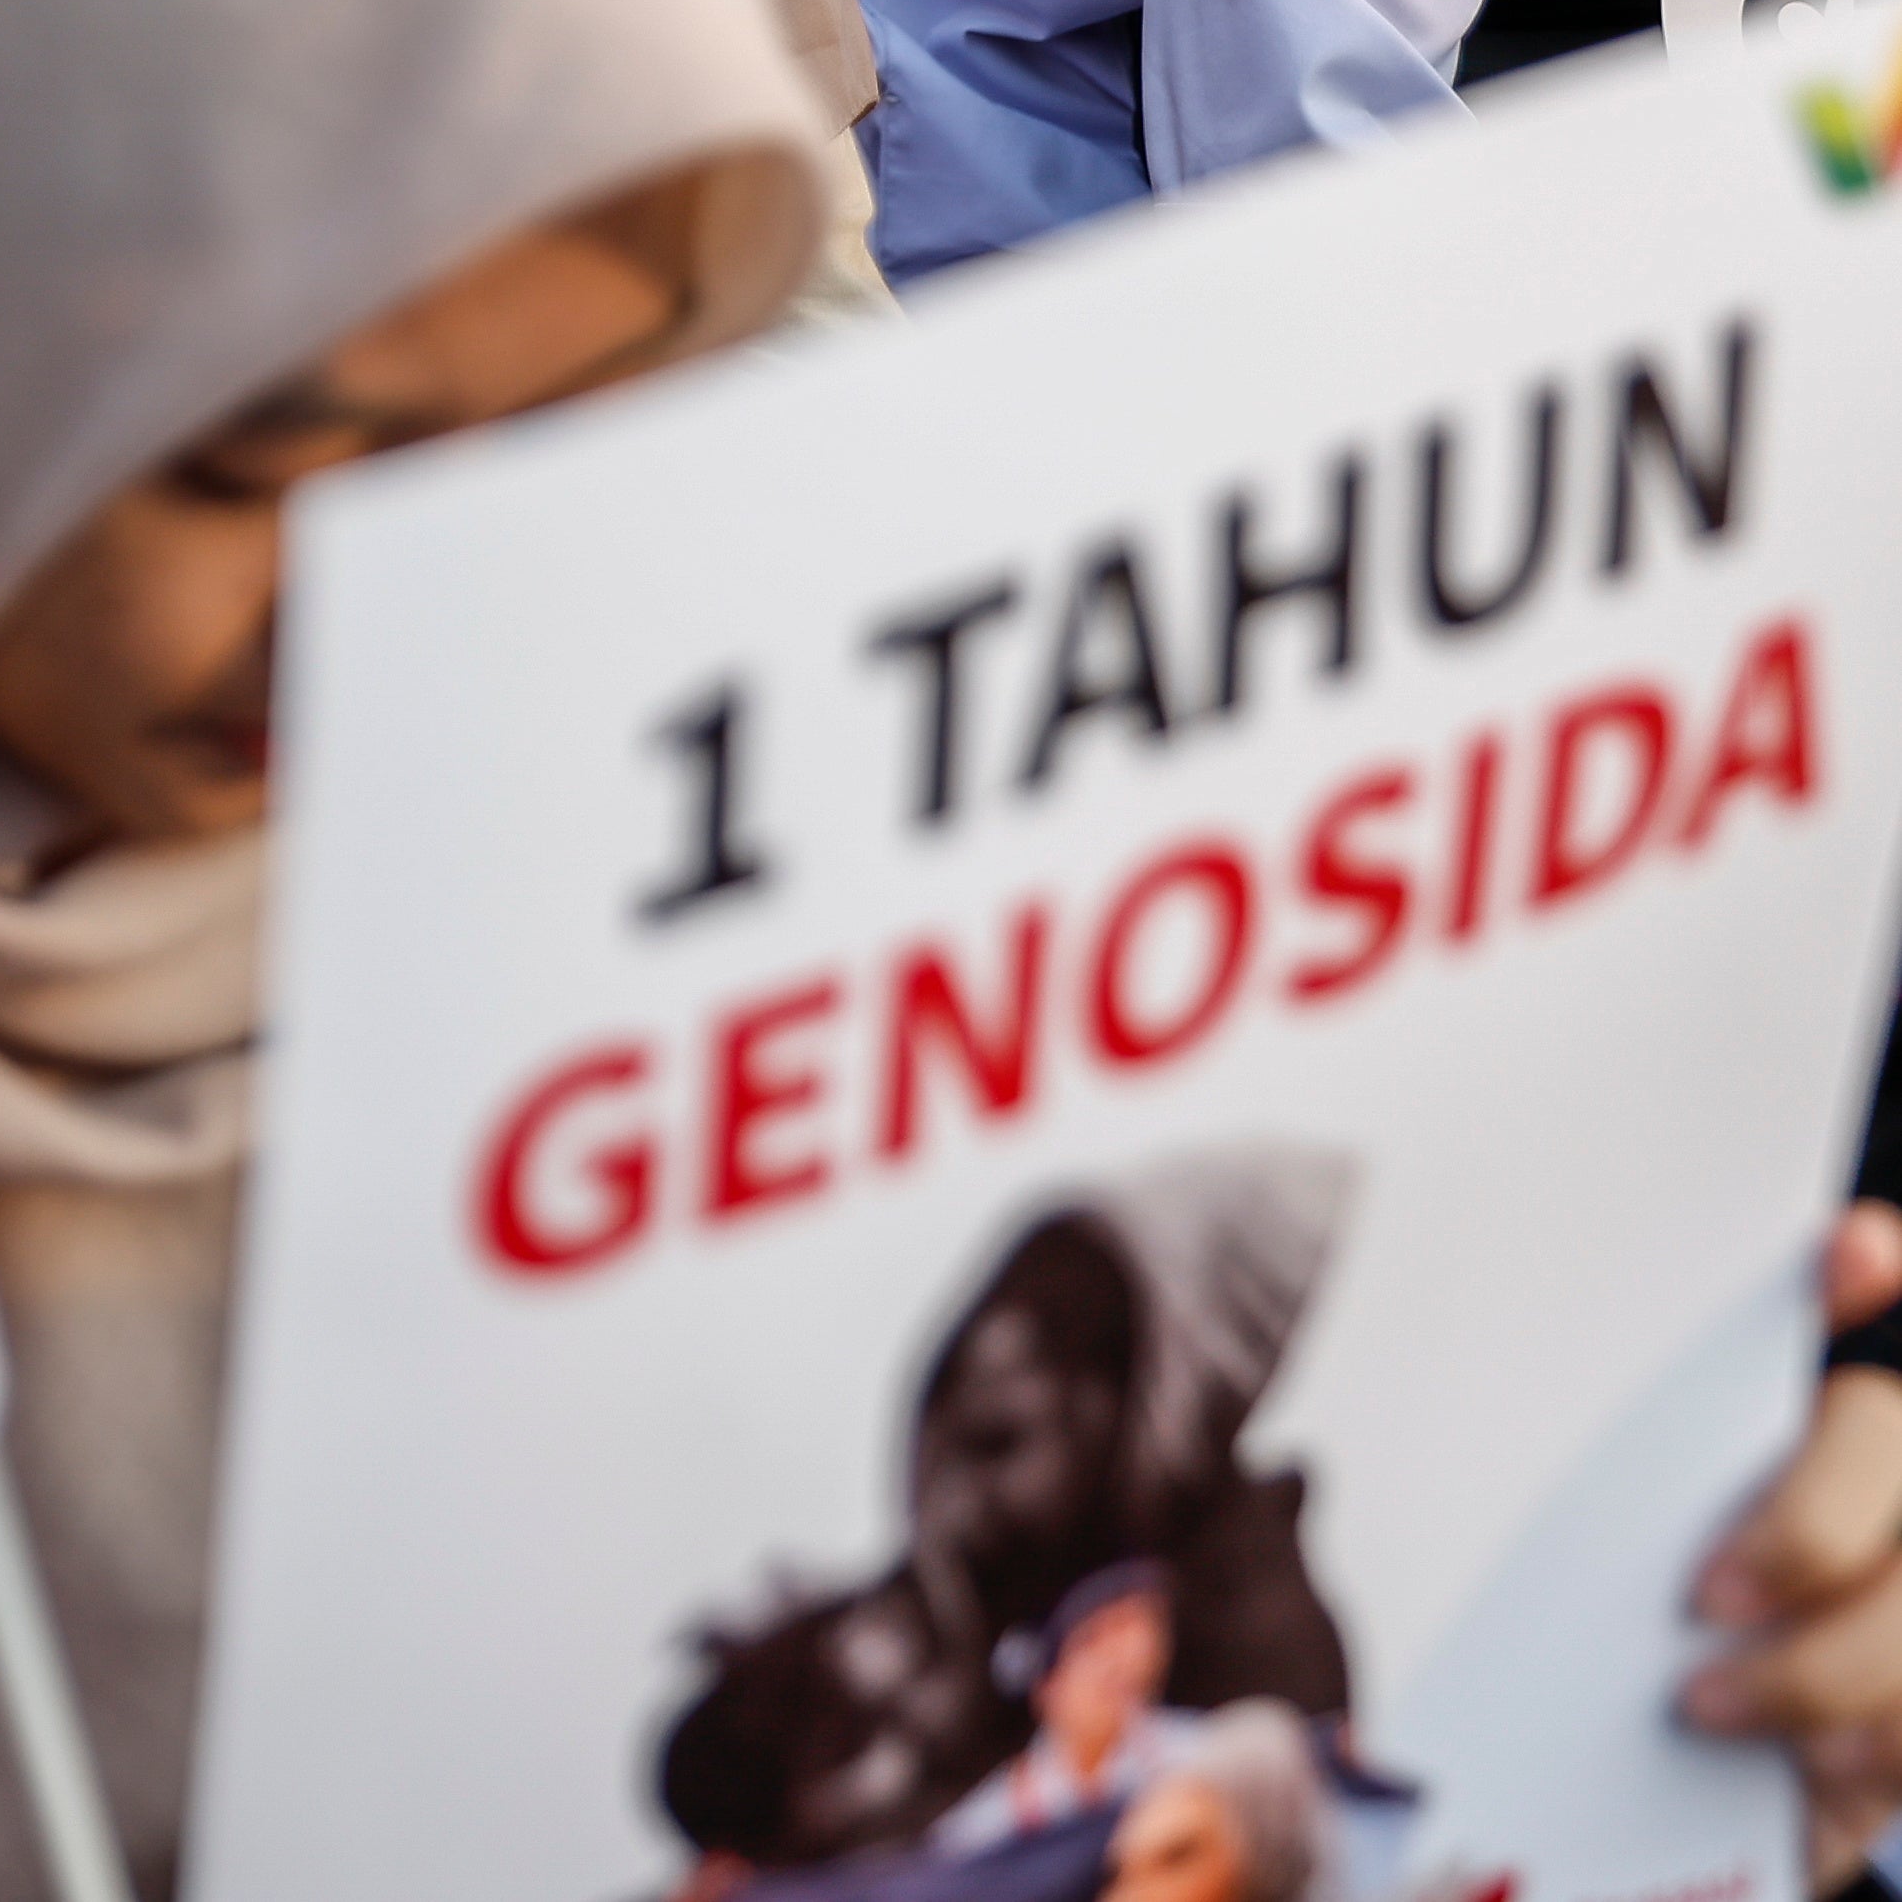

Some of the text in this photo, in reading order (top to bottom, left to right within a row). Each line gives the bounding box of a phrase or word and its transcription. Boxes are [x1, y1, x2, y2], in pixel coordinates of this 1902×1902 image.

[630, 315, 1756, 926] 1 TAHUN
[468, 611, 1828, 1286] GENOSIDA
